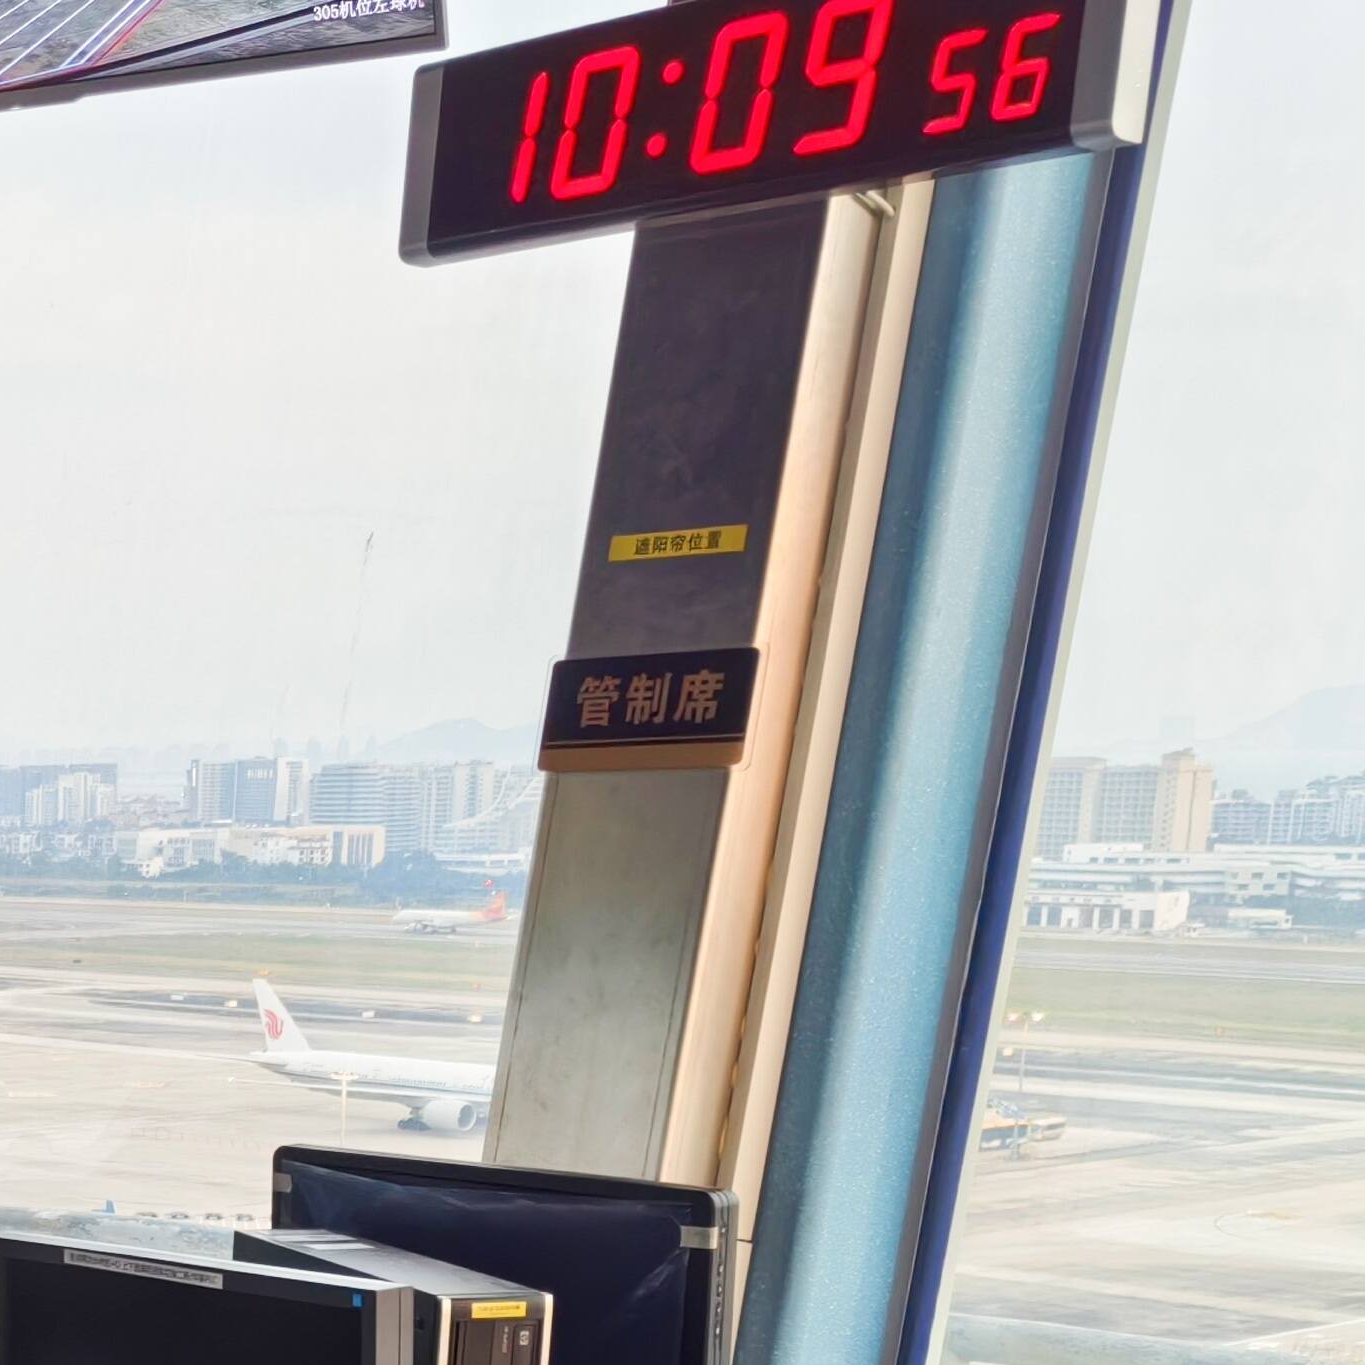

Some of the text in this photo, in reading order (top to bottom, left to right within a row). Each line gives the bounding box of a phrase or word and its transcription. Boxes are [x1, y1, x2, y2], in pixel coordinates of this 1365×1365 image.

[510, 0, 1062, 203] 10:09 56
[576, 669, 725, 729] 管制席
